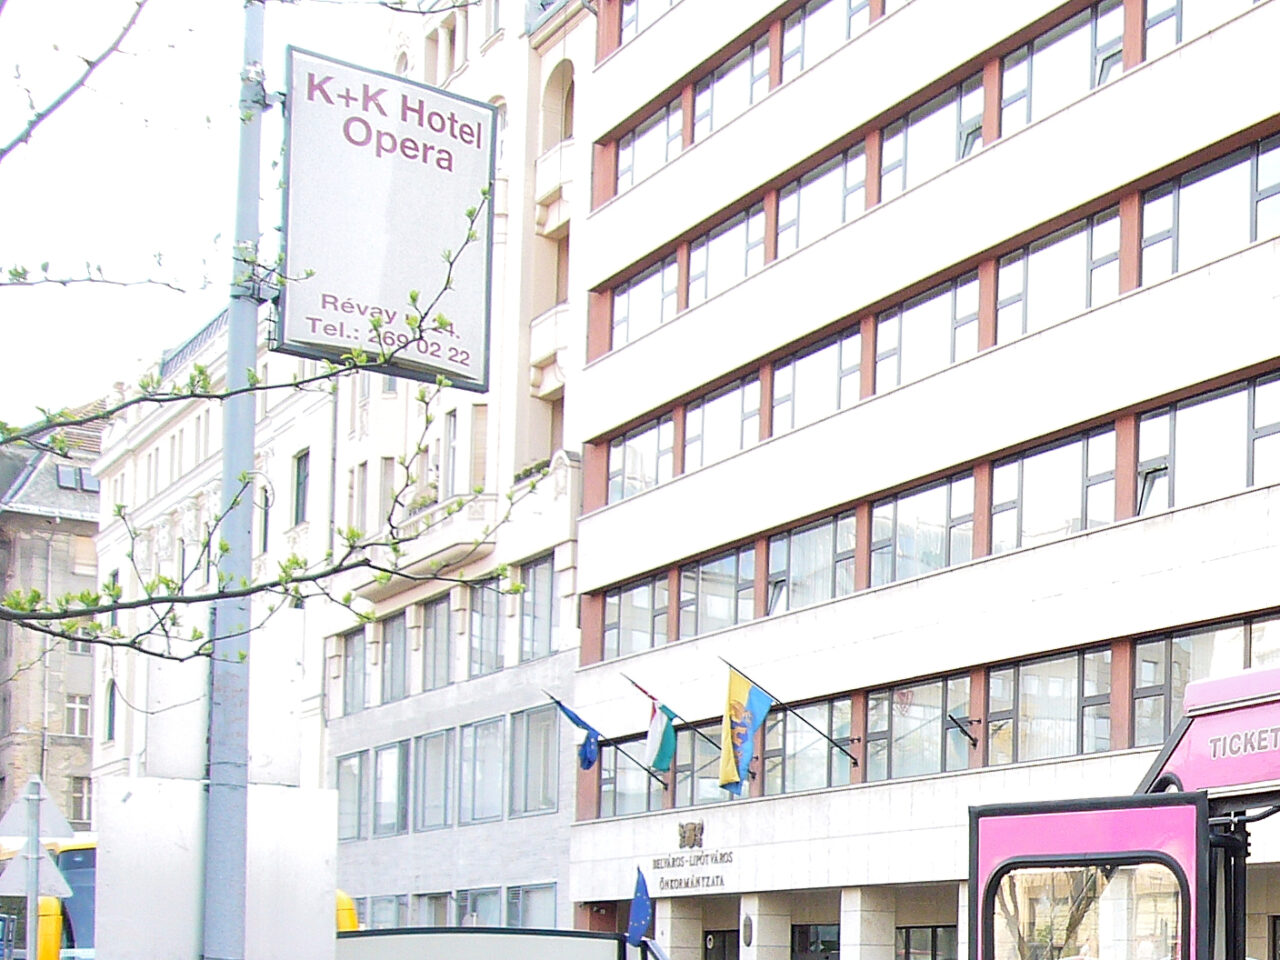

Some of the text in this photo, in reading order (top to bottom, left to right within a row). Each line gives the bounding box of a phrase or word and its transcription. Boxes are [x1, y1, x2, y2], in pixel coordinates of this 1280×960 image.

[306, 72, 482, 149] K+K Hotel
[343, 116, 453, 173] Opera
[321, 293, 397, 325] Révay
[305, 316, 359, 341] Tel.:
[417, 339, 441, 358] 02
[448, 347, 470, 367] 22
